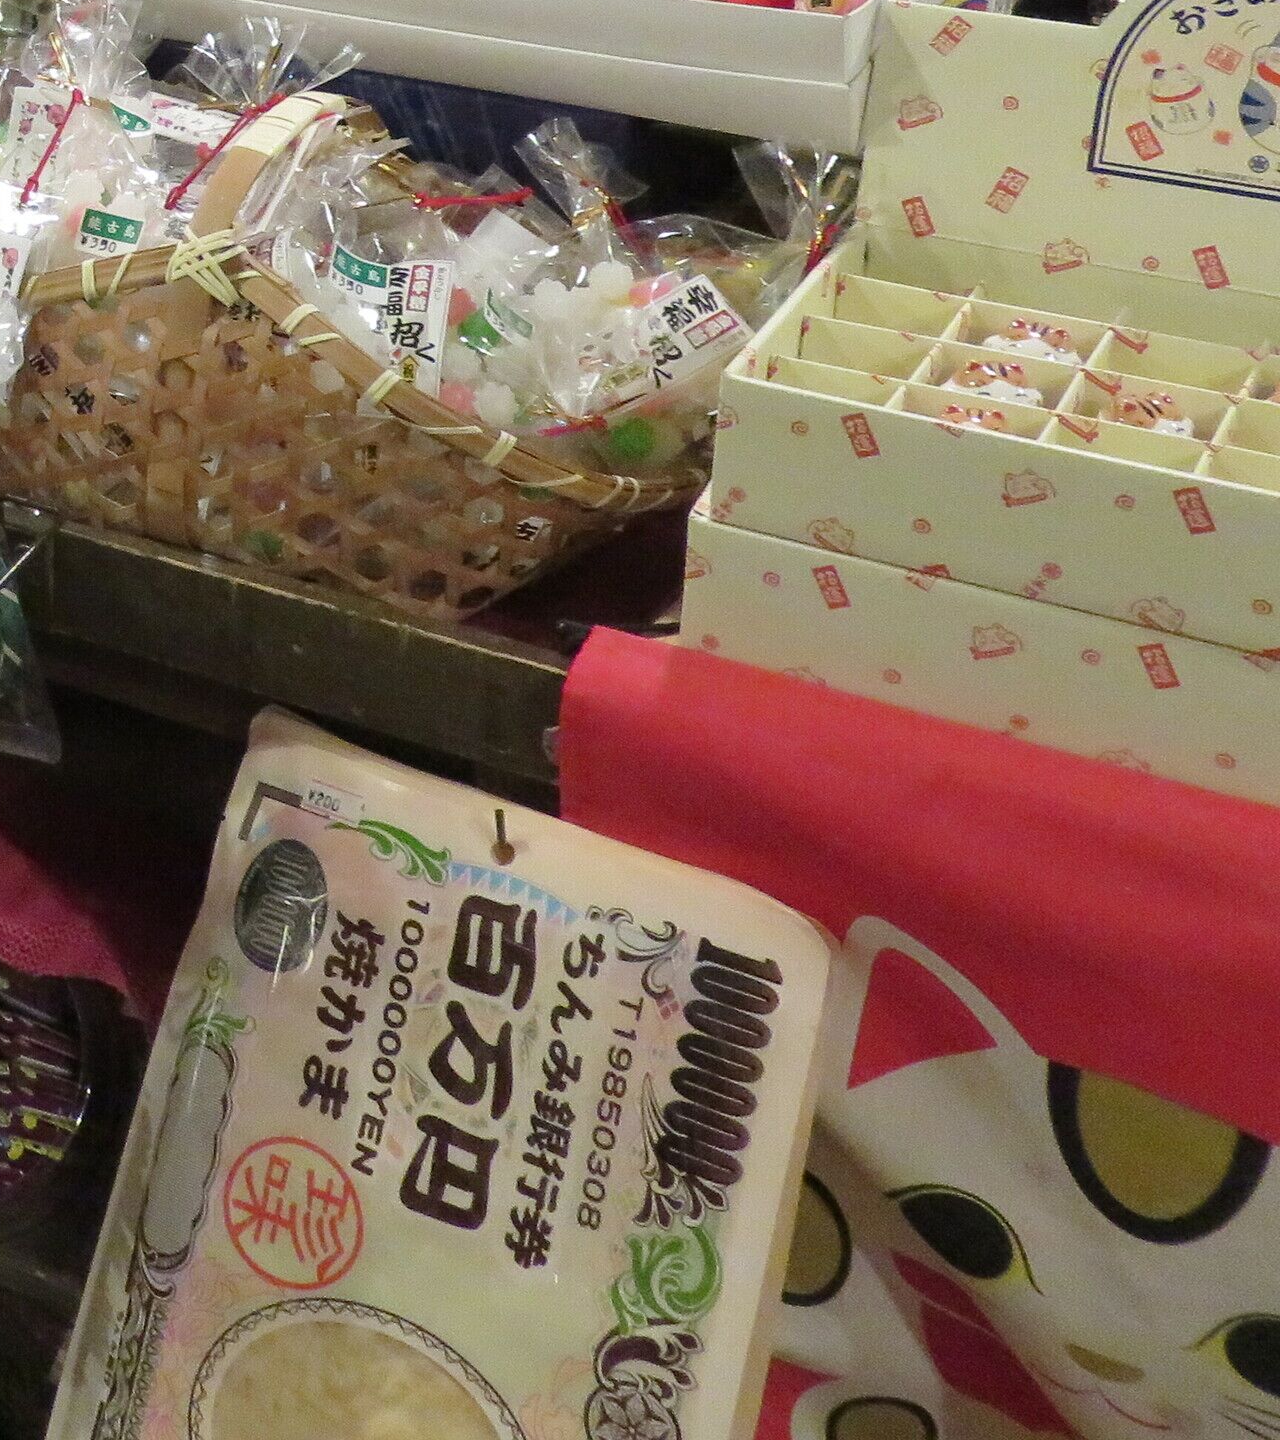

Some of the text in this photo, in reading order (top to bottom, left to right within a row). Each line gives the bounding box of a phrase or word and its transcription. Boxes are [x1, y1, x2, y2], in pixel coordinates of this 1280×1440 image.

[86, 216, 137, 239] 能古島
[298, 910, 386, 1121] 焼かま
[350, 898, 431, 1177] 1000000YEN
[399, 894, 538, 1231] 百万円
[504, 933, 608, 1270] ちんみ銀行券
[576, 995, 646, 1232] T19850308
